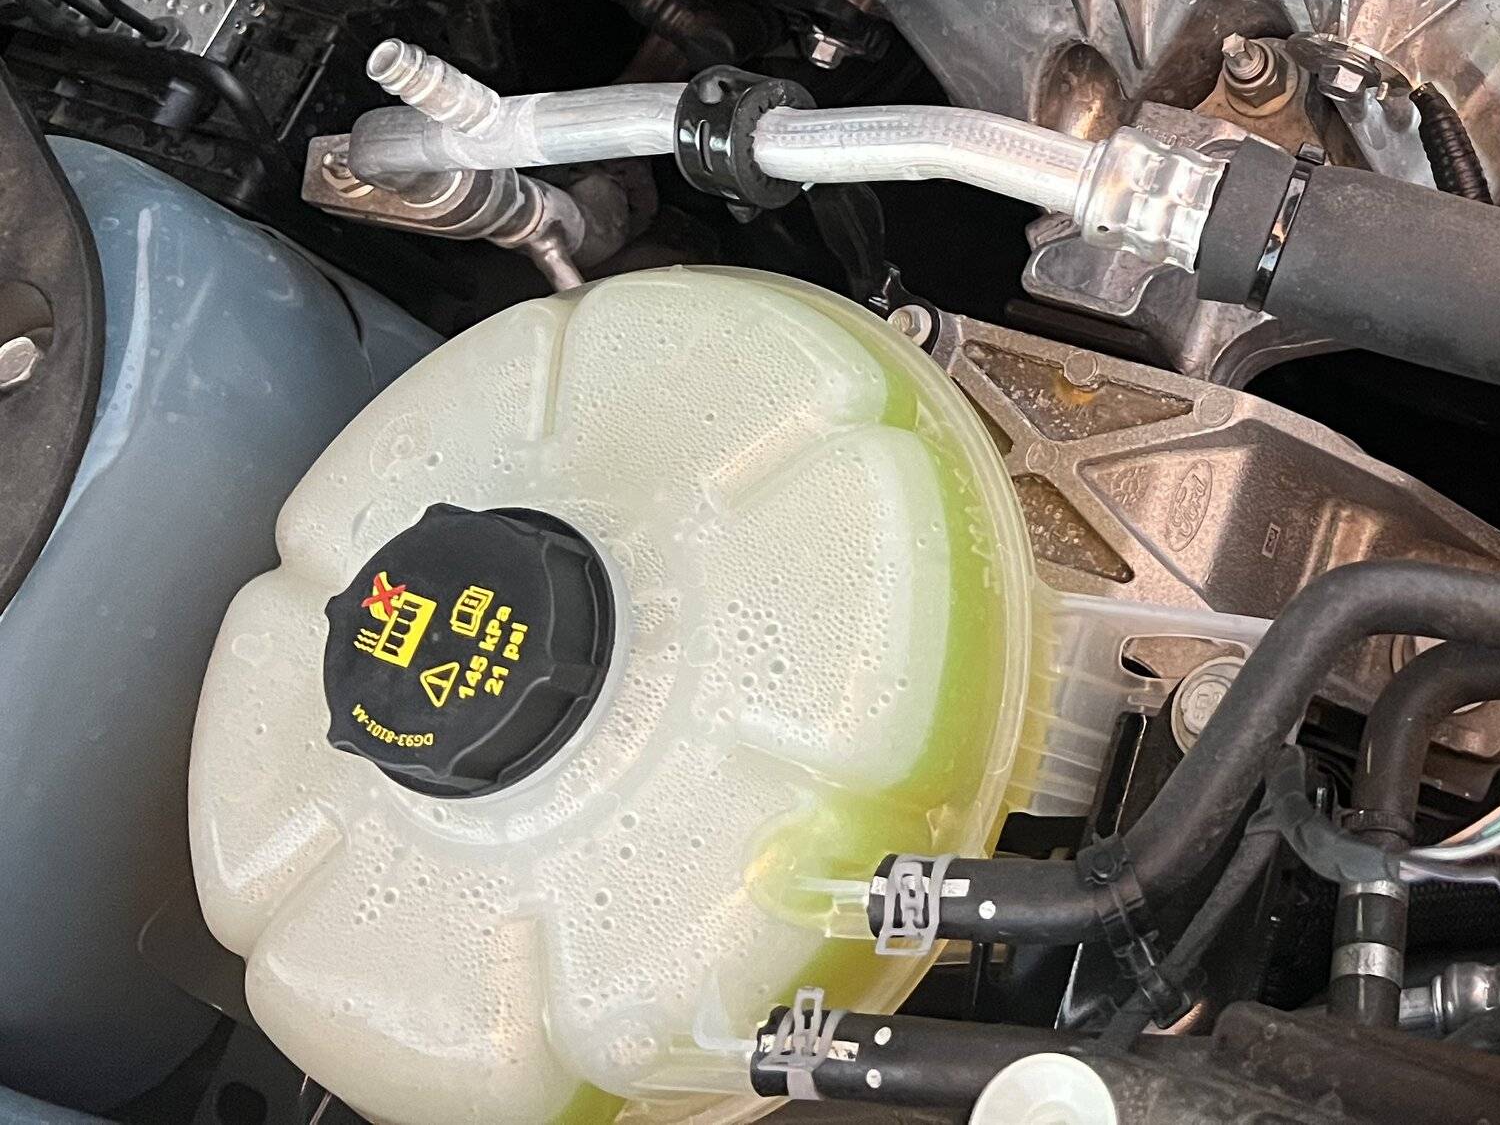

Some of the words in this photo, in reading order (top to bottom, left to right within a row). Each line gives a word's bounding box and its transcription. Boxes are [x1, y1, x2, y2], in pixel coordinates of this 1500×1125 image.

[1171, 472, 1208, 540] Ford
[458, 655, 488, 699] 145
[478, 606, 512, 651] kPa
[484, 666, 509, 696] 21
[502, 622, 528, 661] psi
